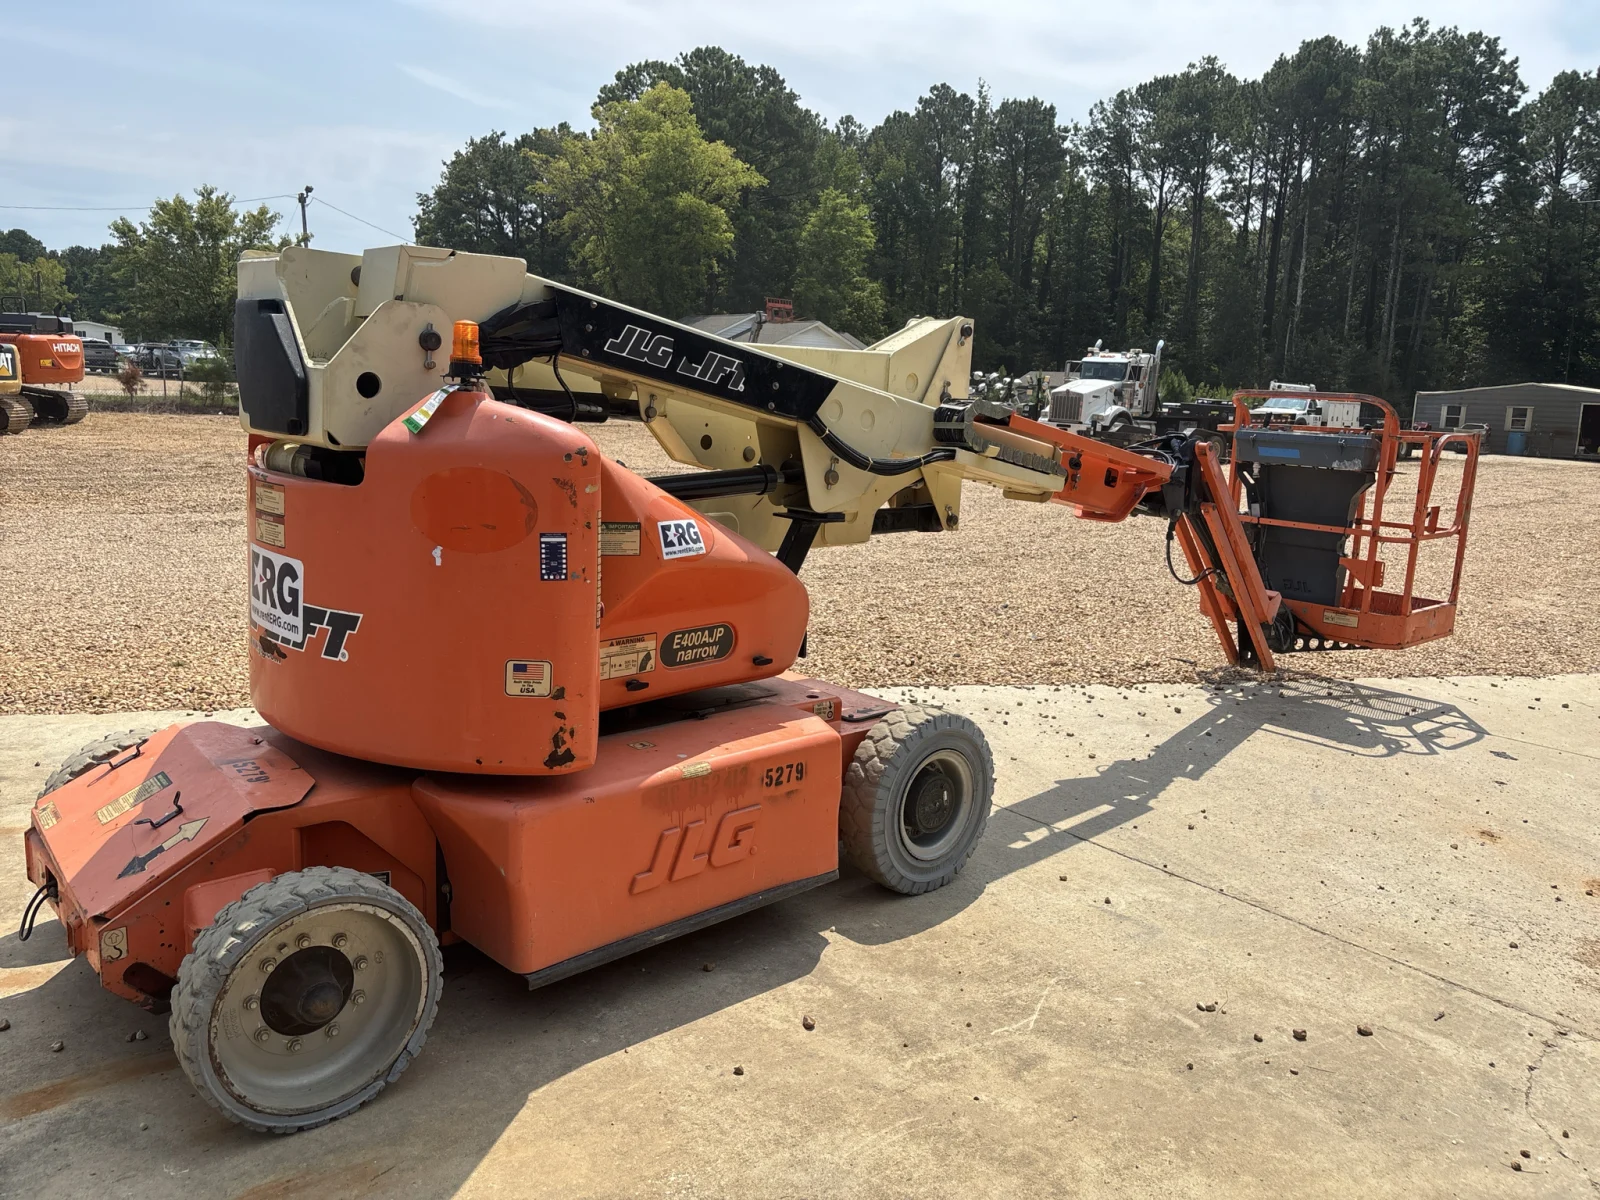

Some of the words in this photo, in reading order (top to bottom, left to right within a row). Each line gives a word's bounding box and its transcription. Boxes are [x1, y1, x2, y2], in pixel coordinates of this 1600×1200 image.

[52, 343, 80, 353] HITACHI
[603, 324, 674, 369] JLG
[0, 352, 13, 376] AT
[660, 522, 702, 549] ERG
[664, 546, 704, 557] www.rentERG.com
[251, 549, 299, 618] ERG
[615, 636, 645, 646] WARNING
[672, 627, 725, 649] E400AJP
[676, 645, 720, 662] narrow
[764, 762, 804, 788] 5279
[628, 803, 762, 896] JLG
